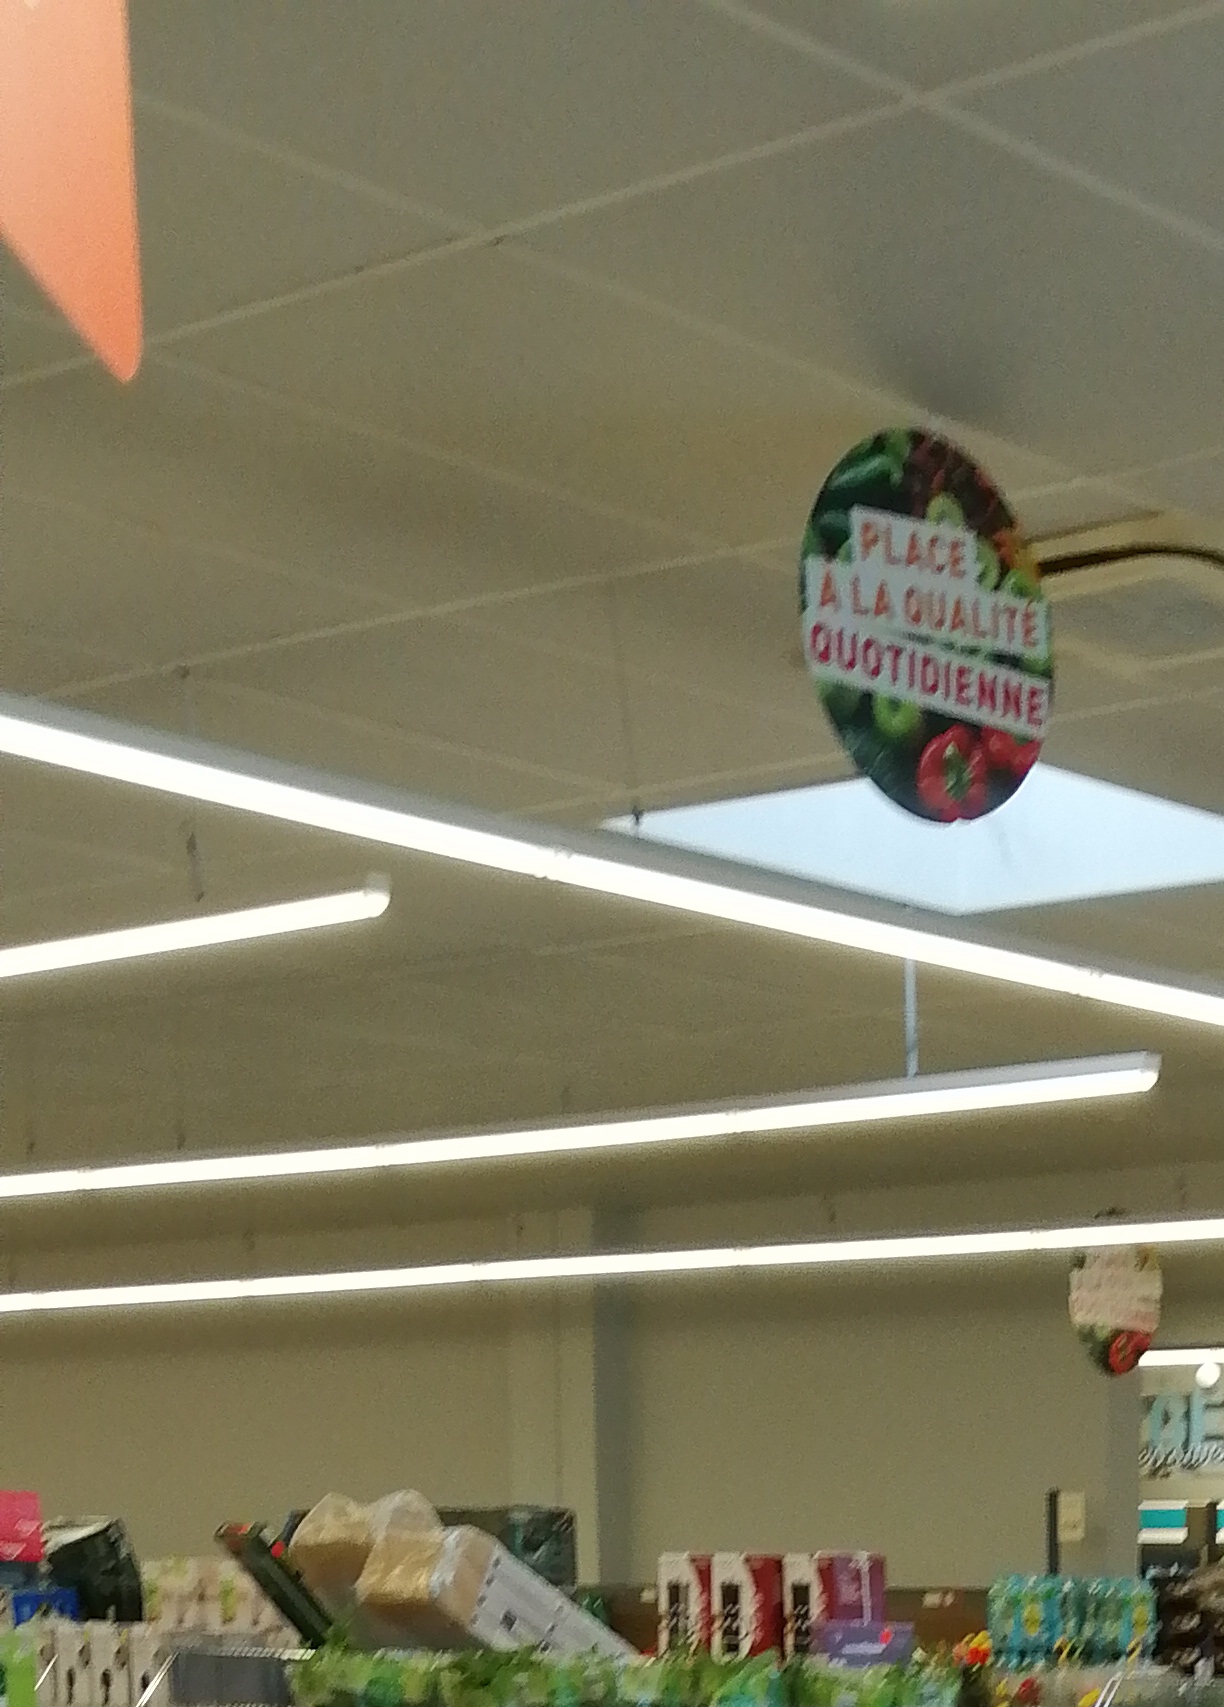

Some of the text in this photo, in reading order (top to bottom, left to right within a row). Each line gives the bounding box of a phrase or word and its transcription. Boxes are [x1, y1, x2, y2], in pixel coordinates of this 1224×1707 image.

[860, 520, 968, 580] PLACE
[850, 575, 892, 618] LA
[903, 585, 1040, 648] QUALITÉ
[809, 620, 1045, 727] QUOTIDIENNE
